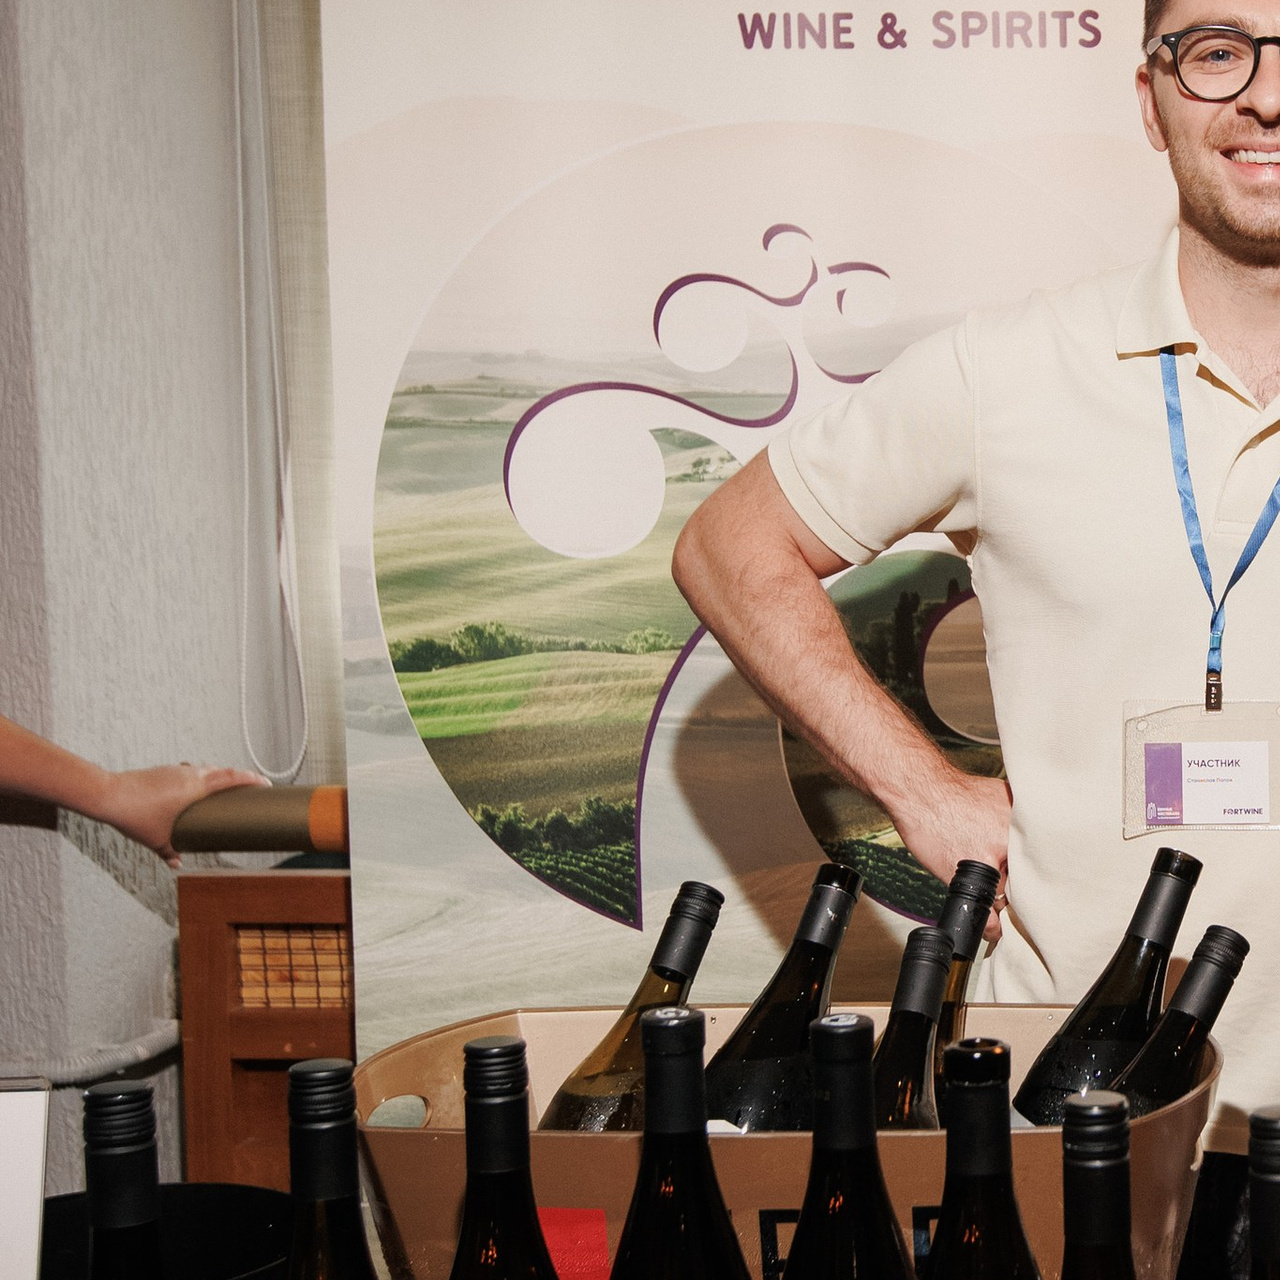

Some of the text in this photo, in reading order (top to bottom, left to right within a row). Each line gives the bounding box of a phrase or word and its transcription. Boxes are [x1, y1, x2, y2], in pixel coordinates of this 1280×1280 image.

[737, 9, 1103, 50] WINE & SPIRITS
[1187, 759, 1241, 768] УЧАСТНИК
